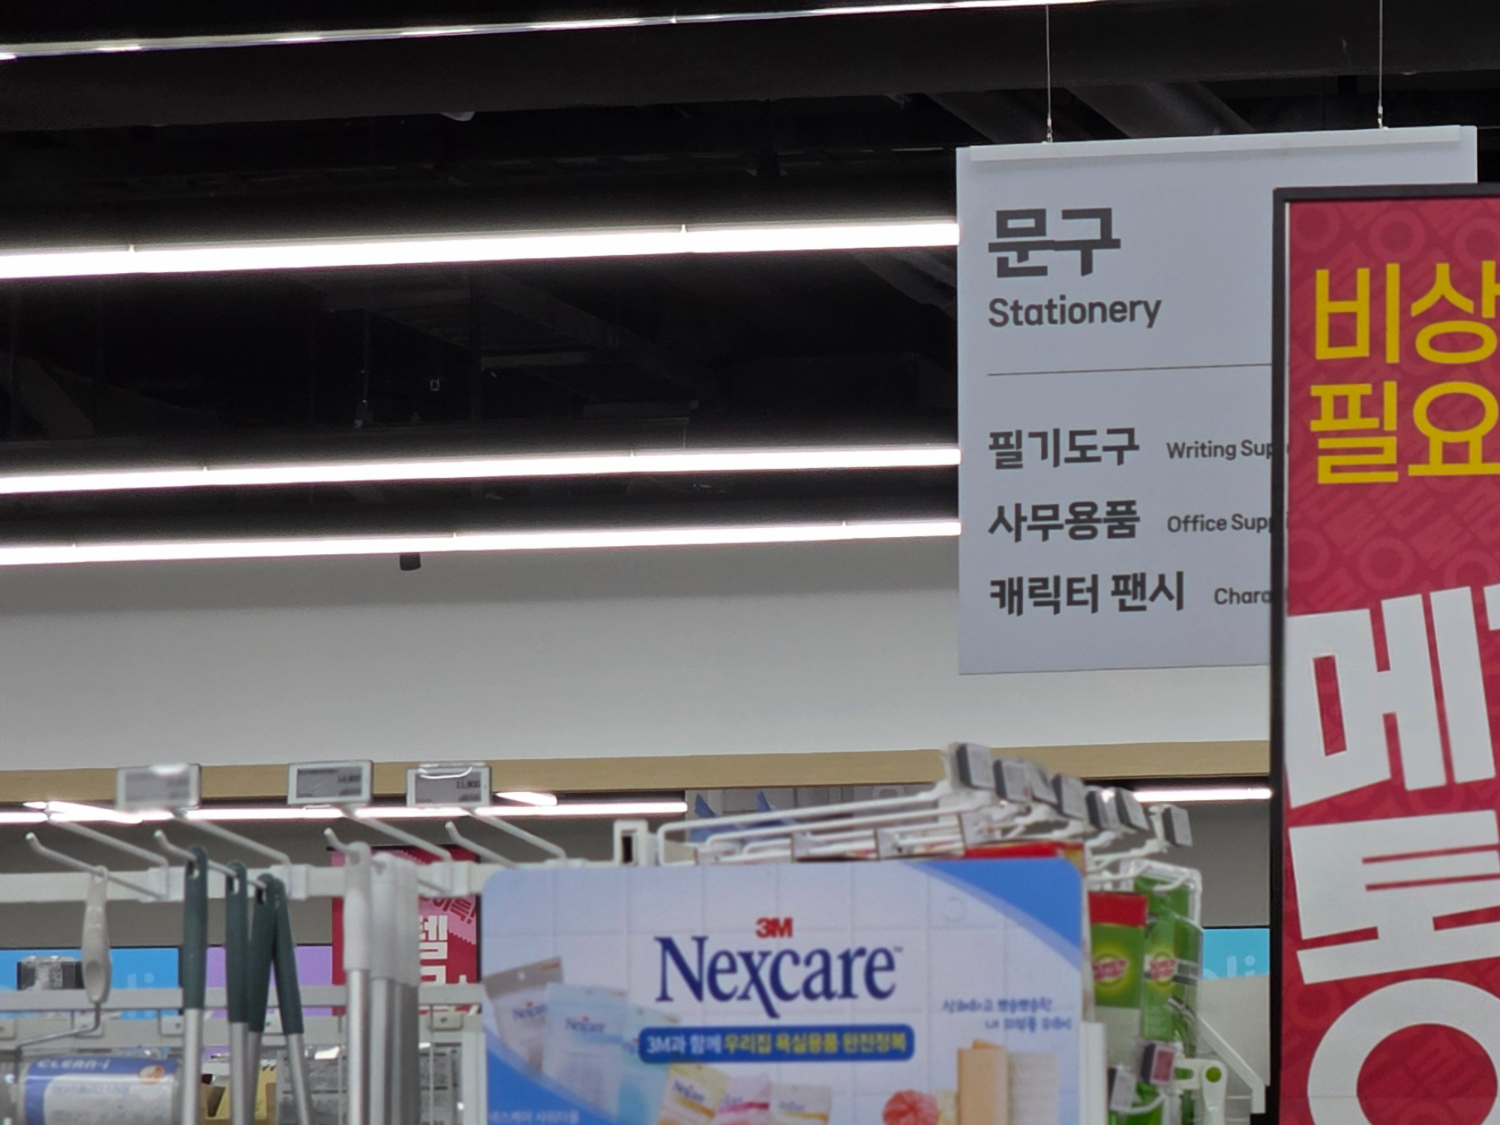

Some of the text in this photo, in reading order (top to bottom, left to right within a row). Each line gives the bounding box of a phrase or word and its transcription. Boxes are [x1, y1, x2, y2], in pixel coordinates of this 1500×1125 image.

[988, 208, 1121, 278] 문구
[988, 295, 1162, 330] Stationery
[988, 427, 1140, 470] 필기도구
[1166, 440, 1237, 461] Writing
[988, 500, 1140, 543] 사무용품
[1167, 513, 1272, 533] Office Sup
[989, 571, 1184, 617] 캐릭터 팬시
[755, 917, 793, 938] 3M
[653, 935, 897, 1019] Nexcare
